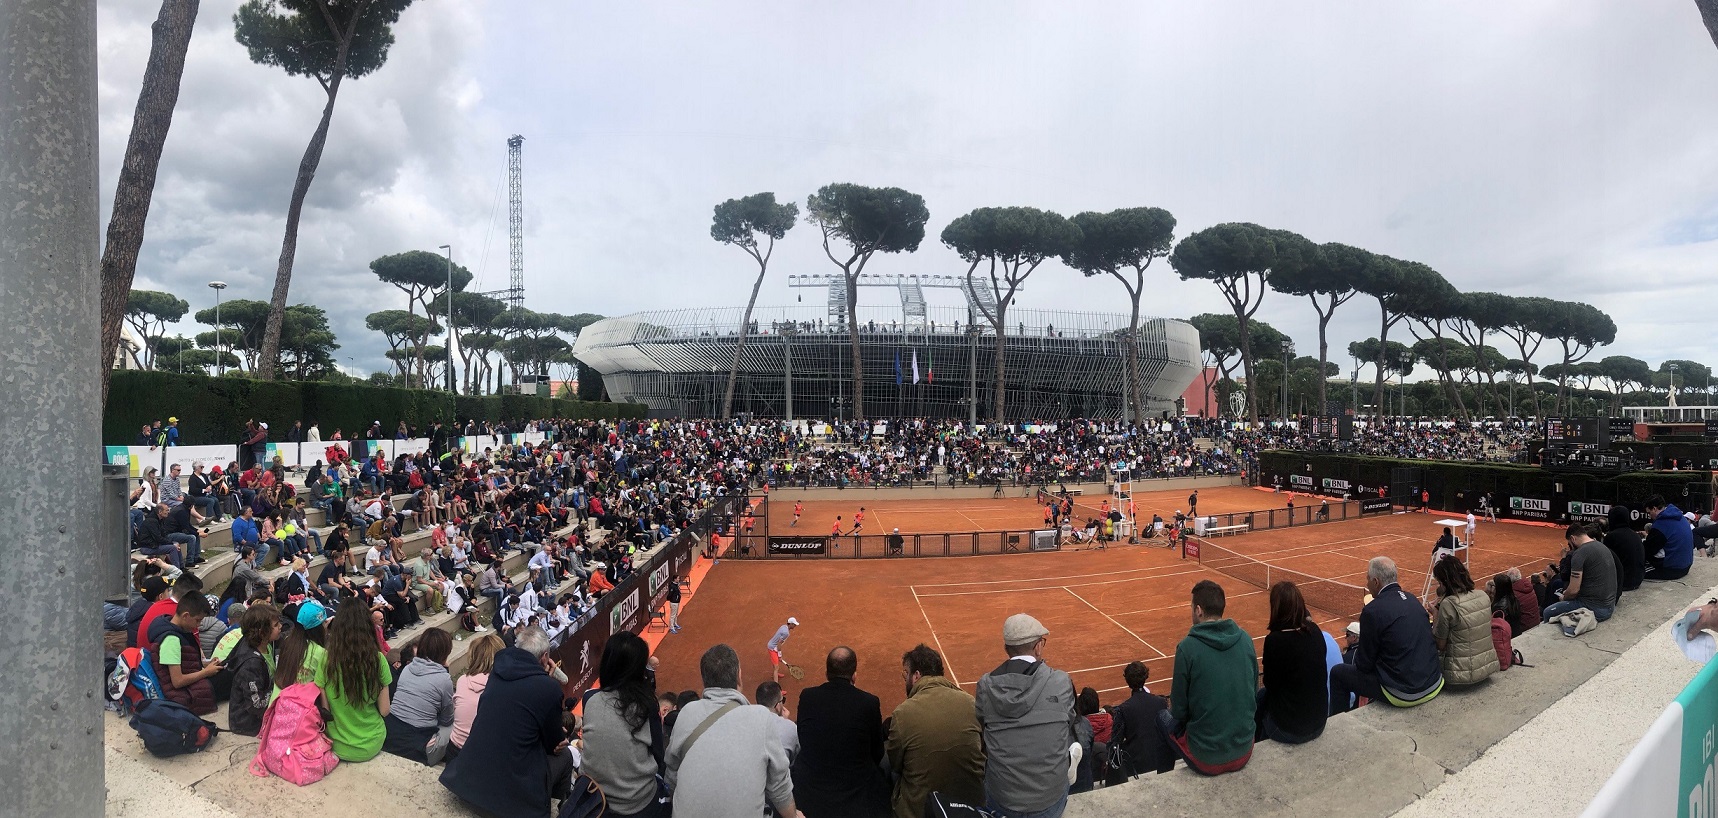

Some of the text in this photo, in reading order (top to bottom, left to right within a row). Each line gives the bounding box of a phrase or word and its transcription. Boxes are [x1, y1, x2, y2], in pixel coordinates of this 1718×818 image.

[1331, 480, 1346, 488] BNL
[1524, 500, 1547, 509] BNL
[1584, 504, 1608, 514] BNL
[1524, 510, 1547, 518] PARIBAS
[656, 563, 668, 587] BNL
[621, 593, 638, 622] BNL
